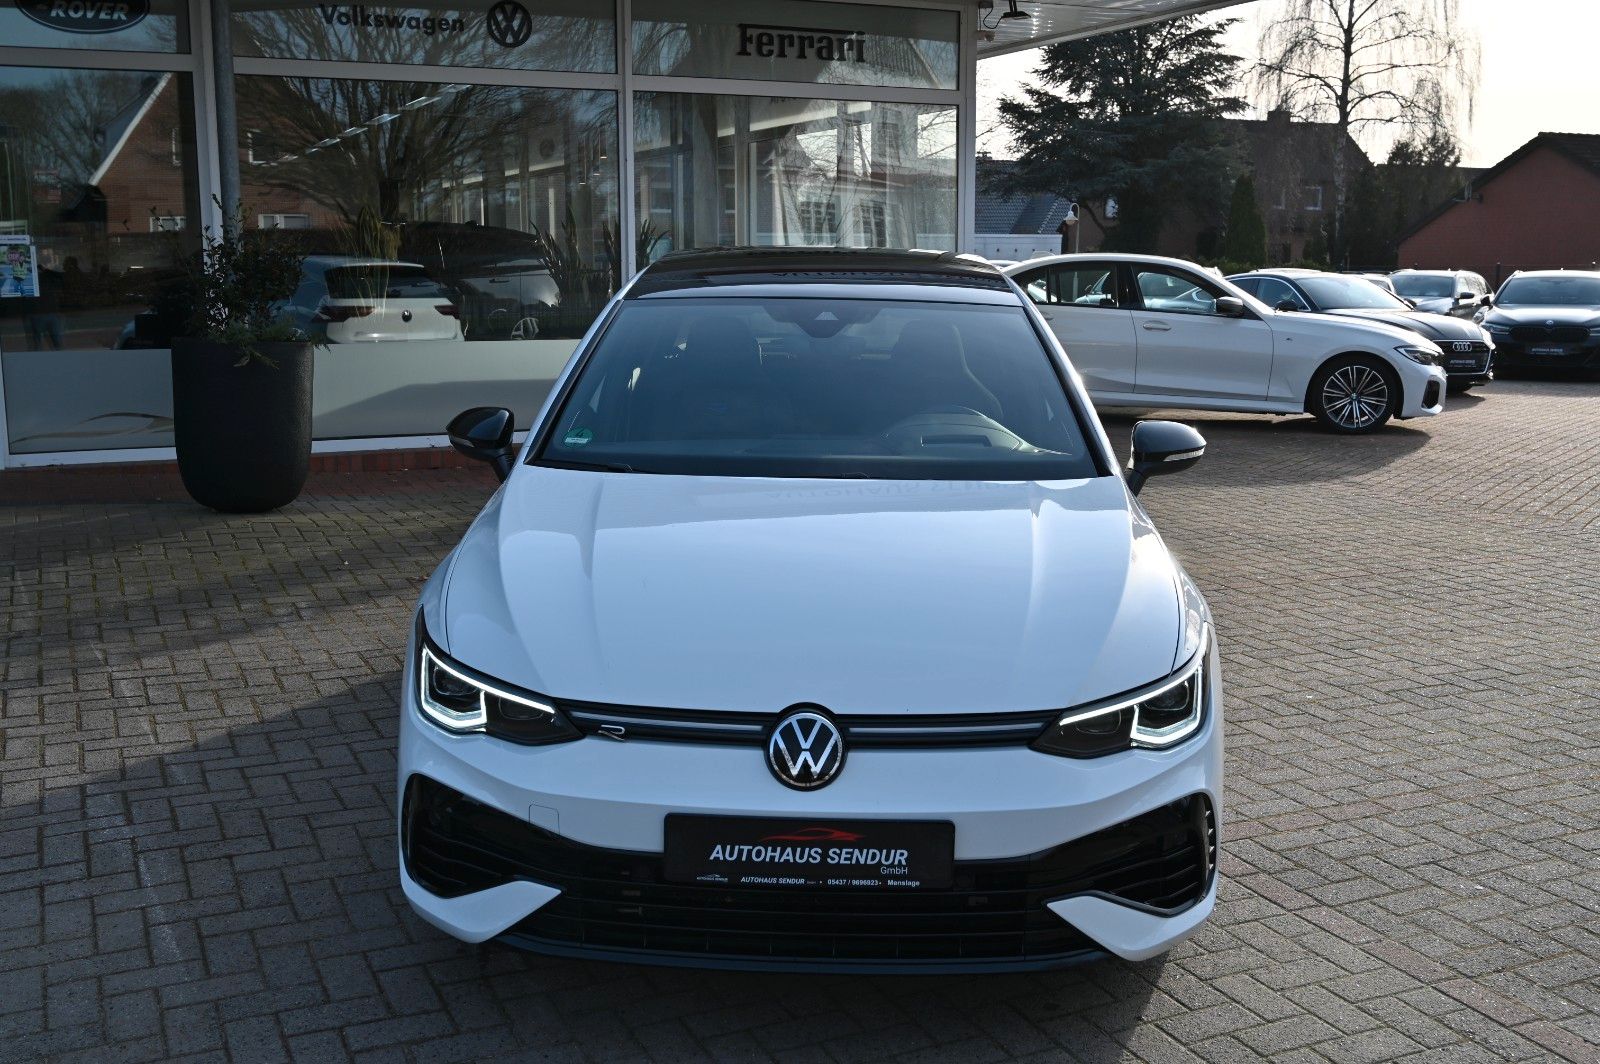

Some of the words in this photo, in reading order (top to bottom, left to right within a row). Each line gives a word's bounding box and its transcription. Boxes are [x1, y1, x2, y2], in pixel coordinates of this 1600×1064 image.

[51, 0, 129, 20] ROVER
[319, 4, 465, 35] Volkswagen
[736, 23, 866, 63] Ferrari
[709, 844, 823, 864] AUTOHAUS
[827, 847, 908, 866] SENDUR
[740, 876, 777, 884] AUTOHAUS
[778, 877, 805, 885] SENDUR
[880, 866, 908, 875] GmbH
[887, 879, 920, 888] Menslage
